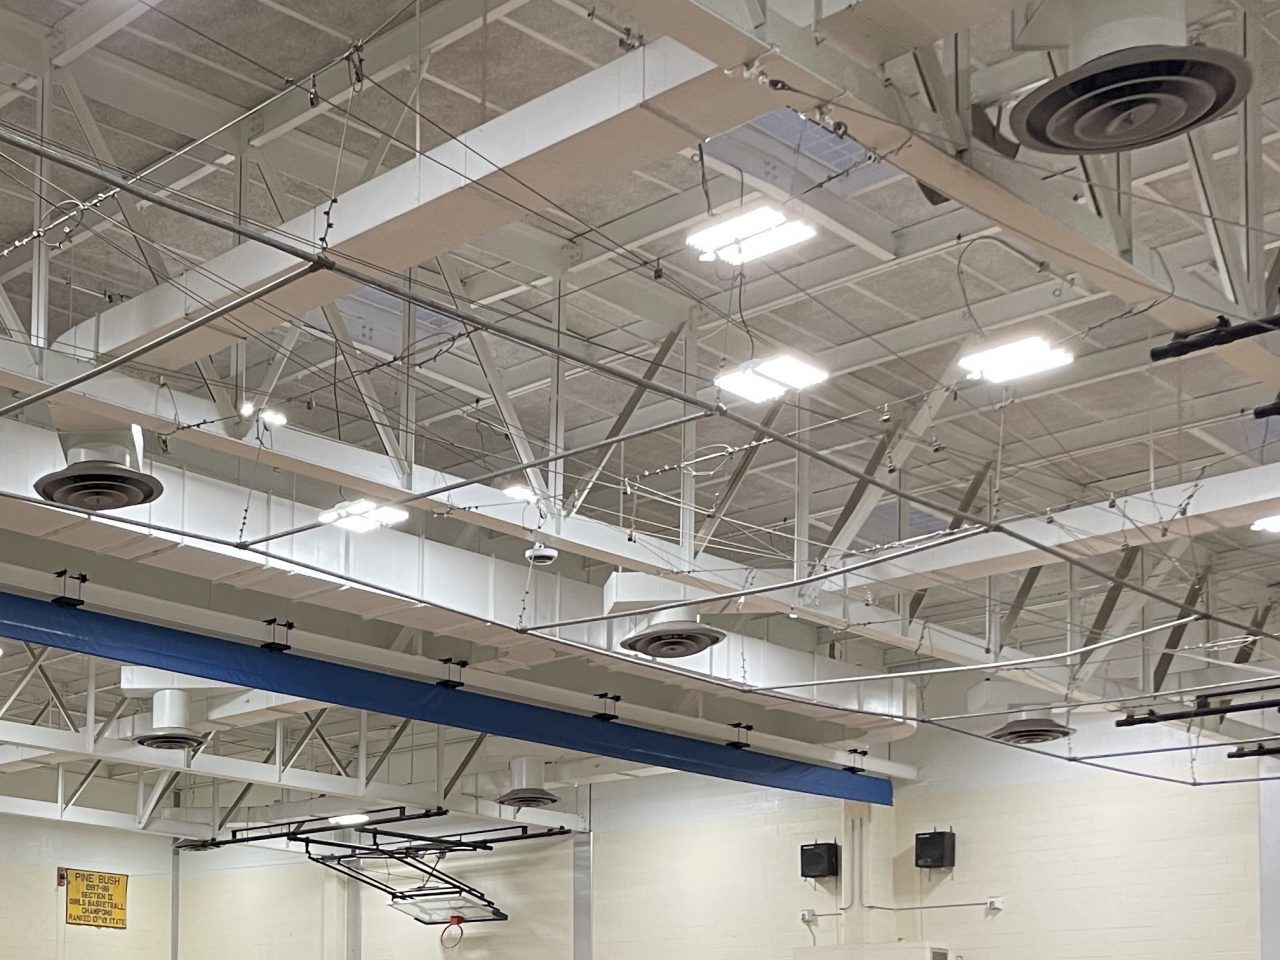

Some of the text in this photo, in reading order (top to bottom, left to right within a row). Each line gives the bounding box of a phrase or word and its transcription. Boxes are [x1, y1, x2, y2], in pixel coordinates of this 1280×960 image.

[75, 872, 120, 886] PINE BUSH
[81, 892, 106, 900] SECTION
[88, 900, 126, 910] BASKETBALL
